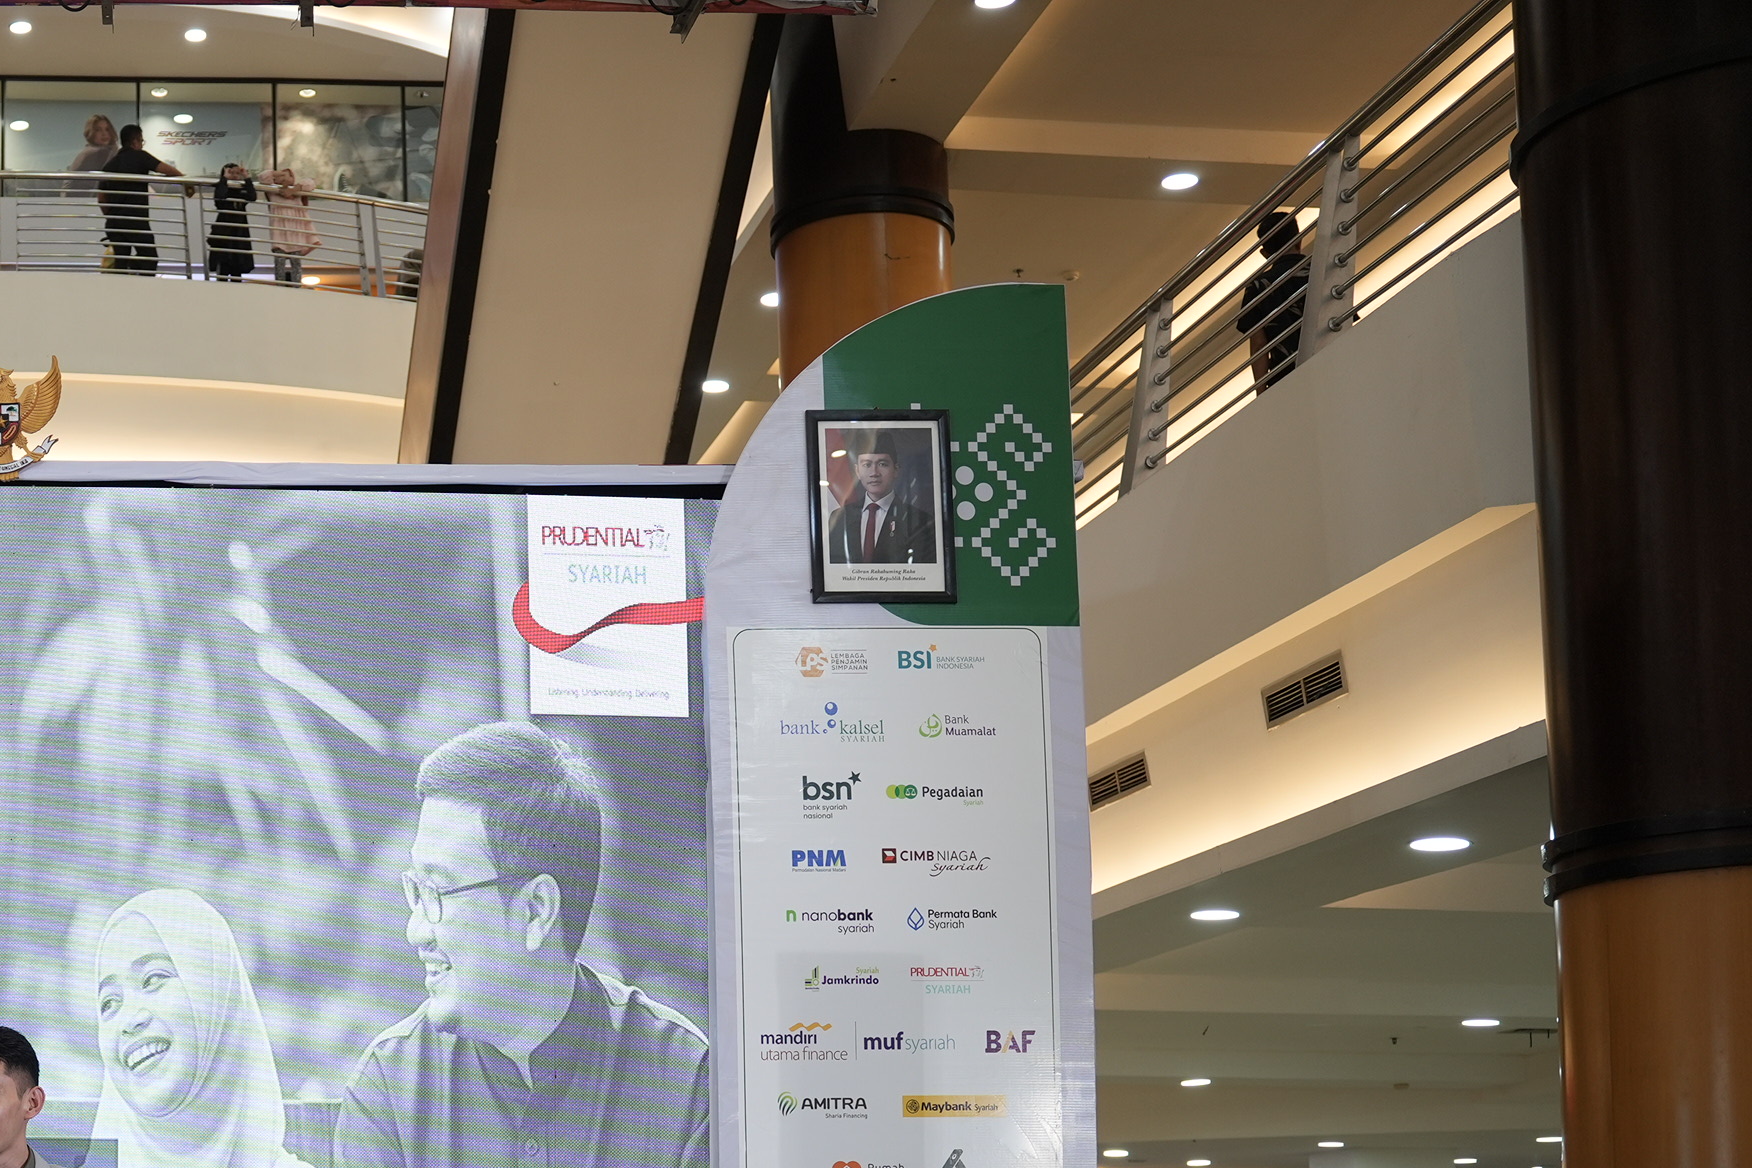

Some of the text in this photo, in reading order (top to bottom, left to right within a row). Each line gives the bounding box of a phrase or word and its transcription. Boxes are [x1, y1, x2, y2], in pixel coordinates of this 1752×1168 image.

[162, 137, 217, 145] SPORT
[542, 525, 646, 548] PRUDENTIAL
[568, 564, 646, 584] SYARIAH
[897, 650, 932, 670] BSI
[944, 714, 970, 724] Bank
[780, 719, 885, 735] bank kalsel
[945, 726, 996, 737] Muamalat
[840, 735, 886, 743] SYARIAH
[802, 775, 853, 801] bsn
[922, 785, 984, 800] Pegadaian
[822, 804, 848, 812] syariah
[791, 849, 847, 867] PNM
[900, 850, 978, 862] CIMB NIAGA
[801, 908, 874, 922] nanobank
[927, 909, 998, 919] Permata Bank
[837, 923, 875, 935] syariah
[928, 919, 965, 931] Syariah
[855, 966, 880, 976] Syariah
[910, 967, 970, 978] PRUDENTIAL
[821, 975, 879, 986] Jamkrindo
[925, 984, 971, 994] SYARIAH
[760, 1030, 818, 1045] mandiri
[985, 1030, 1036, 1053] BAF
[760, 1046, 848, 1061] utama finance
[801, 1097, 867, 1111] AMITRA
[921, 1101, 998, 1113] Maybank Syariah
